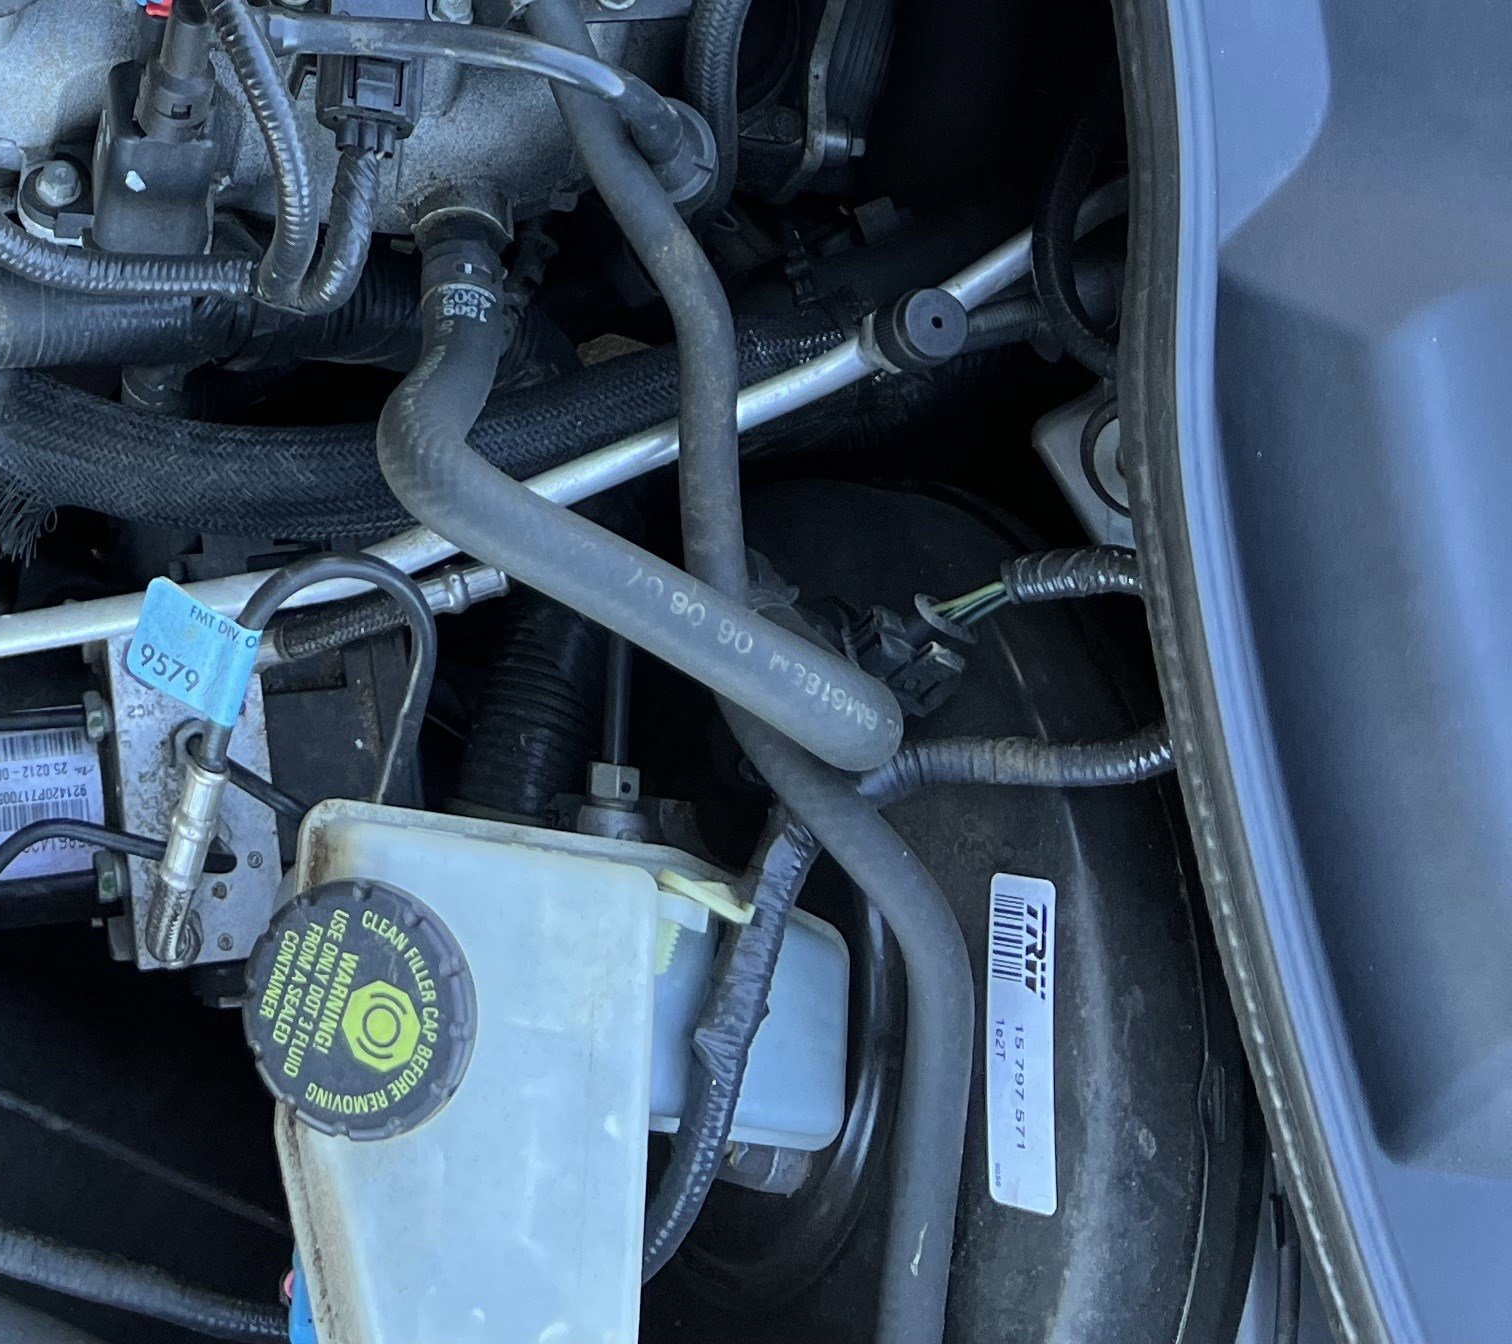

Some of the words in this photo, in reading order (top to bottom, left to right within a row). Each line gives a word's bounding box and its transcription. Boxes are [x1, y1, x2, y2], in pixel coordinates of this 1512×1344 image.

[189, 605, 216, 629] FMT
[217, 620, 241, 645] DIV.
[669, 590, 706, 627] 06
[717, 618, 754, 654] 06
[140, 643, 200, 693] 9579
[327, 909, 349, 942] USE
[362, 910, 409, 951] CLEAN
[296, 922, 324, 971] FROM
[315, 942, 339, 984] ONLY
[1024, 901, 1049, 1001] TRW
[259, 930, 300, 1020] CONTAINER
[291, 969, 307, 984] A
[403, 946, 437, 1003] FILLER
[272, 984, 303, 1045] SEALED
[305, 984, 325, 1018] DOT
[313, 951, 359, 1054] WARNING!
[298, 1016, 314, 1032] 3
[422, 1006, 439, 1044] CAP
[1014, 1024, 1025, 1050] 15
[283, 1030, 310, 1079] FLUID
[393, 1042, 433, 1102] BEFORE
[304, 1082, 389, 1114] REMOVING
[1014, 1059, 1025, 1100] 797
[1015, 1109, 1026, 1150] 571
